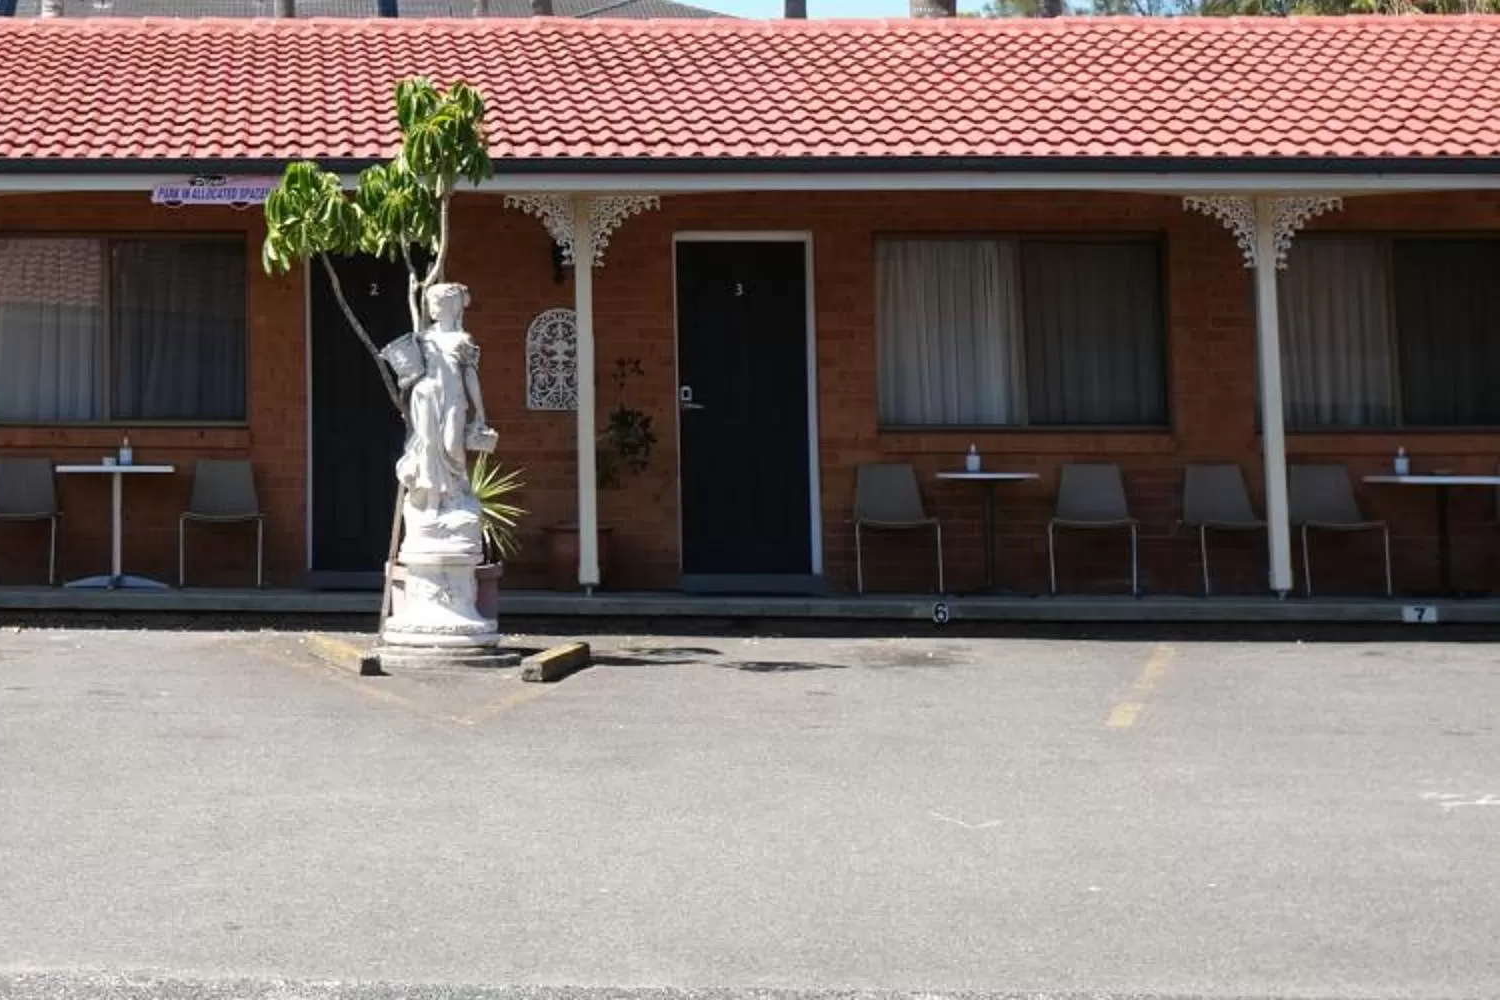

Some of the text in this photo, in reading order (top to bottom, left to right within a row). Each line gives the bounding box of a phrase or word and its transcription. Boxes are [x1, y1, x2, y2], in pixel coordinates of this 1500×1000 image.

[158, 187, 179, 199] PARK
[182, 187, 189, 199] IN
[191, 187, 237, 199] ALLOCATED
[369, 283, 380, 296] 2
[735, 283, 743, 296] 3
[934, 602, 948, 621] 6
[1414, 606, 1426, 621] 7
